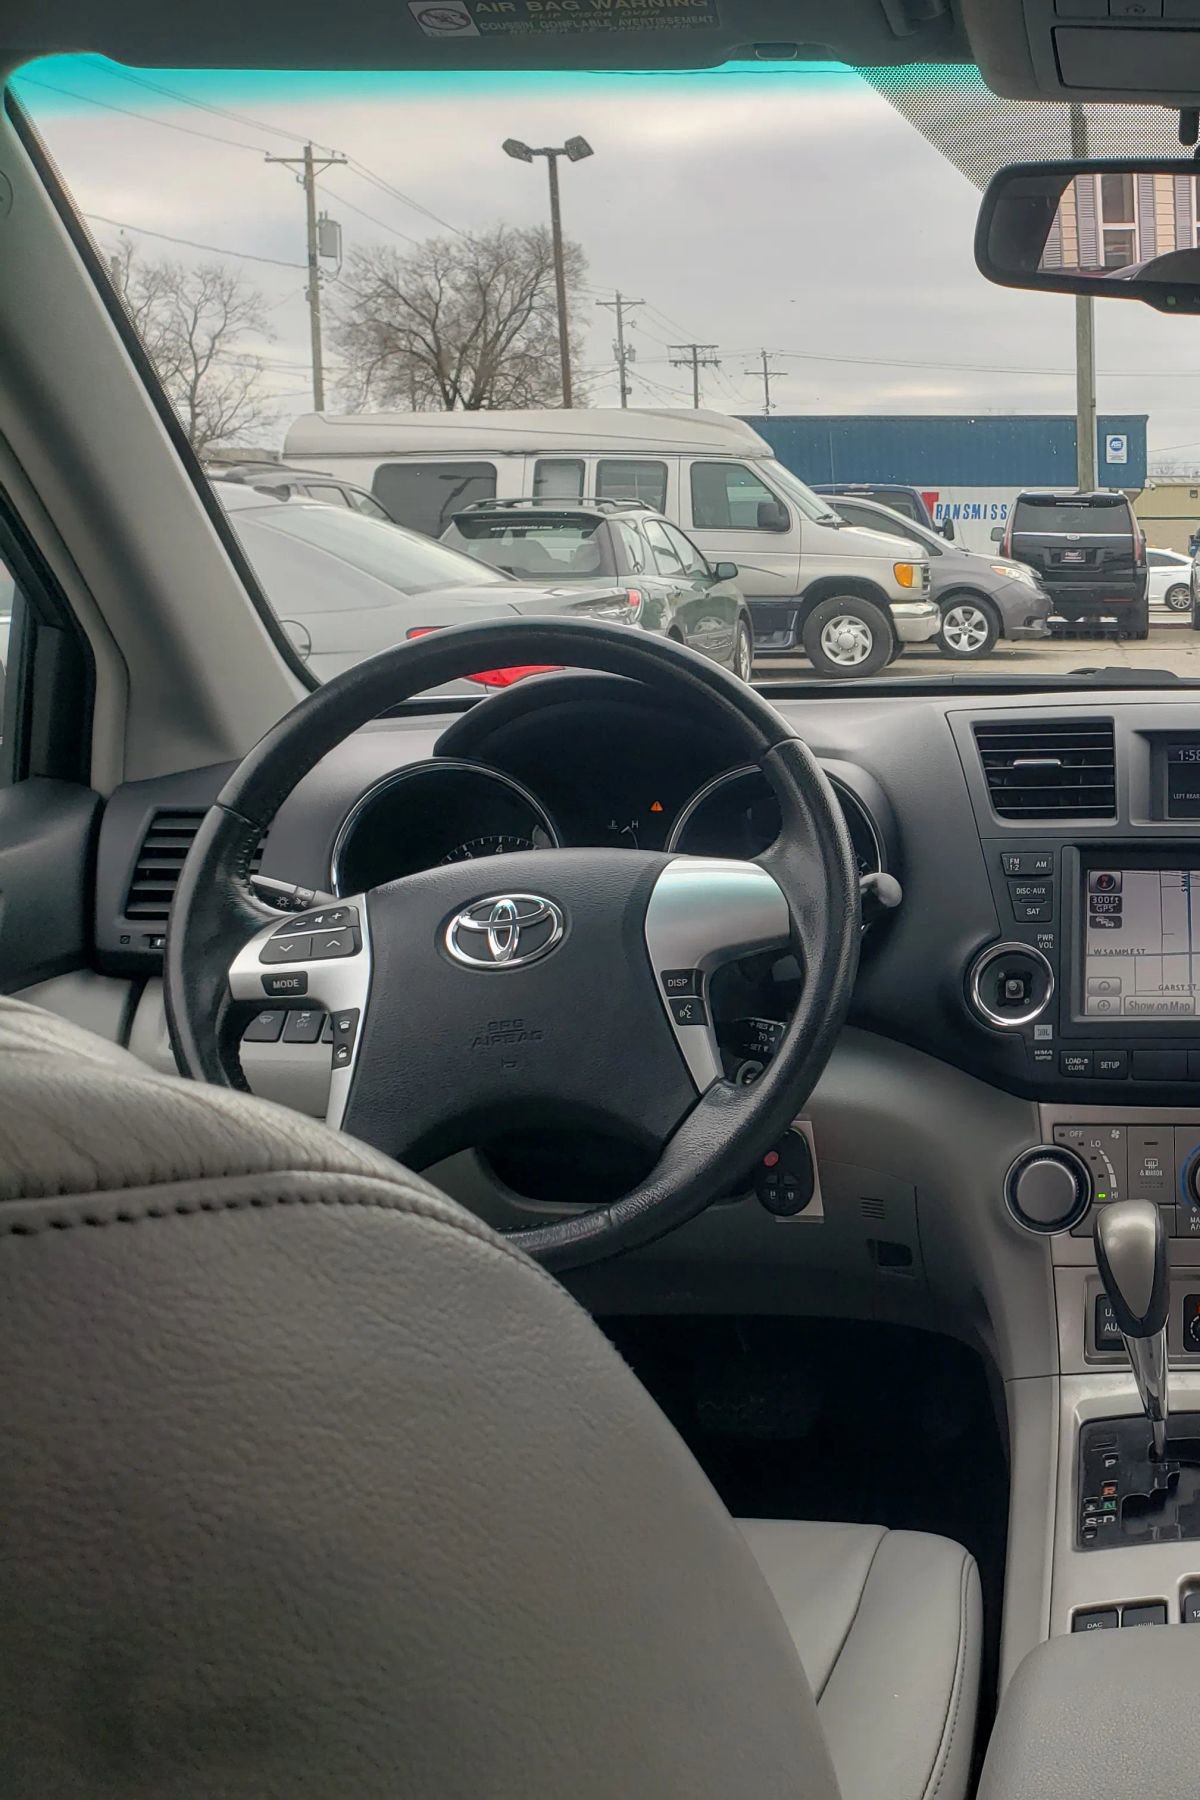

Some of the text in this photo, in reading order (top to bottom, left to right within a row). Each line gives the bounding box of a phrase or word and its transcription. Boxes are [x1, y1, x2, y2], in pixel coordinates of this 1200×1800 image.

[475, 0, 708, 13] AIR BAG WARNING
[1035, 860, 1047, 868] AM
[1091, 896, 1120, 904] 300ft
[1026, 907, 1041, 915] SAT
[1038, 941, 1054, 949] VOL
[273, 978, 300, 989] MODE
[667, 978, 689, 988] DISP
[1129, 1000, 1191, 1012] Show on Map
[1068, 1063, 1085, 1071] CLOSE
[1100, 1060, 1120, 1070] SETUP
[1069, 1130, 1084, 1138] OFF
[1110, 1191, 1118, 1199] HI
[1105, 1459, 1117, 1468] P
[1103, 1486, 1116, 1496] R
